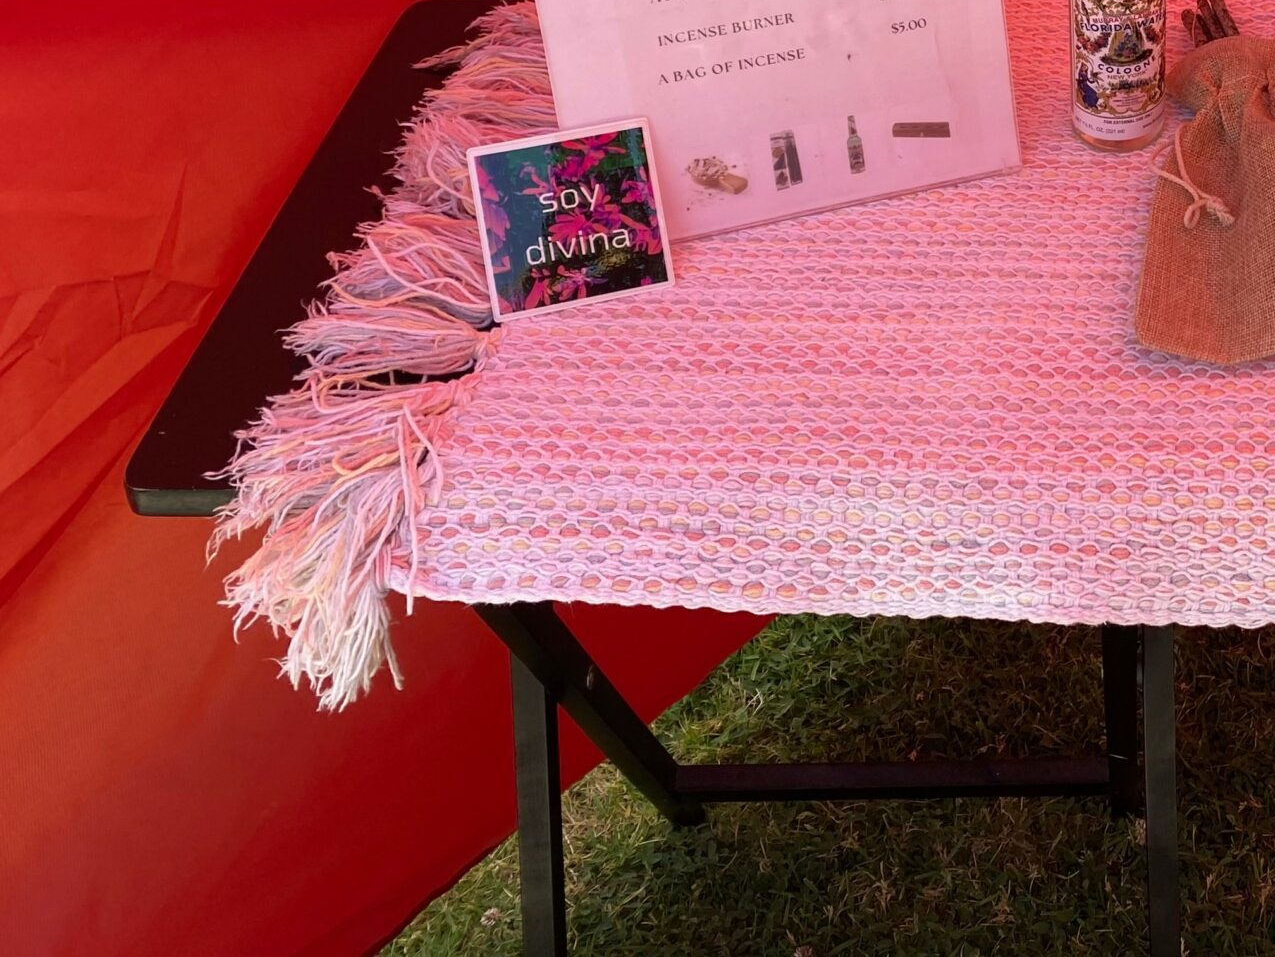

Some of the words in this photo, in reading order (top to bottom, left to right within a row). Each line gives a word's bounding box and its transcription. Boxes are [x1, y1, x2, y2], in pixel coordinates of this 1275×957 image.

[657, 24, 728, 47] INCENSE
[731, 12, 795, 34] BURNER
[891, 18, 927, 34] $5.00
[1080, 22, 1132, 33] FLORIDA
[658, 74, 669, 86] A
[673, 66, 707, 83] BAG
[711, 61, 733, 75] OF
[738, 48, 806, 71] INCENSE
[1097, 54, 1157, 75] COLOGNE
[539, 183, 600, 213] soy
[525, 228, 632, 266] divina
